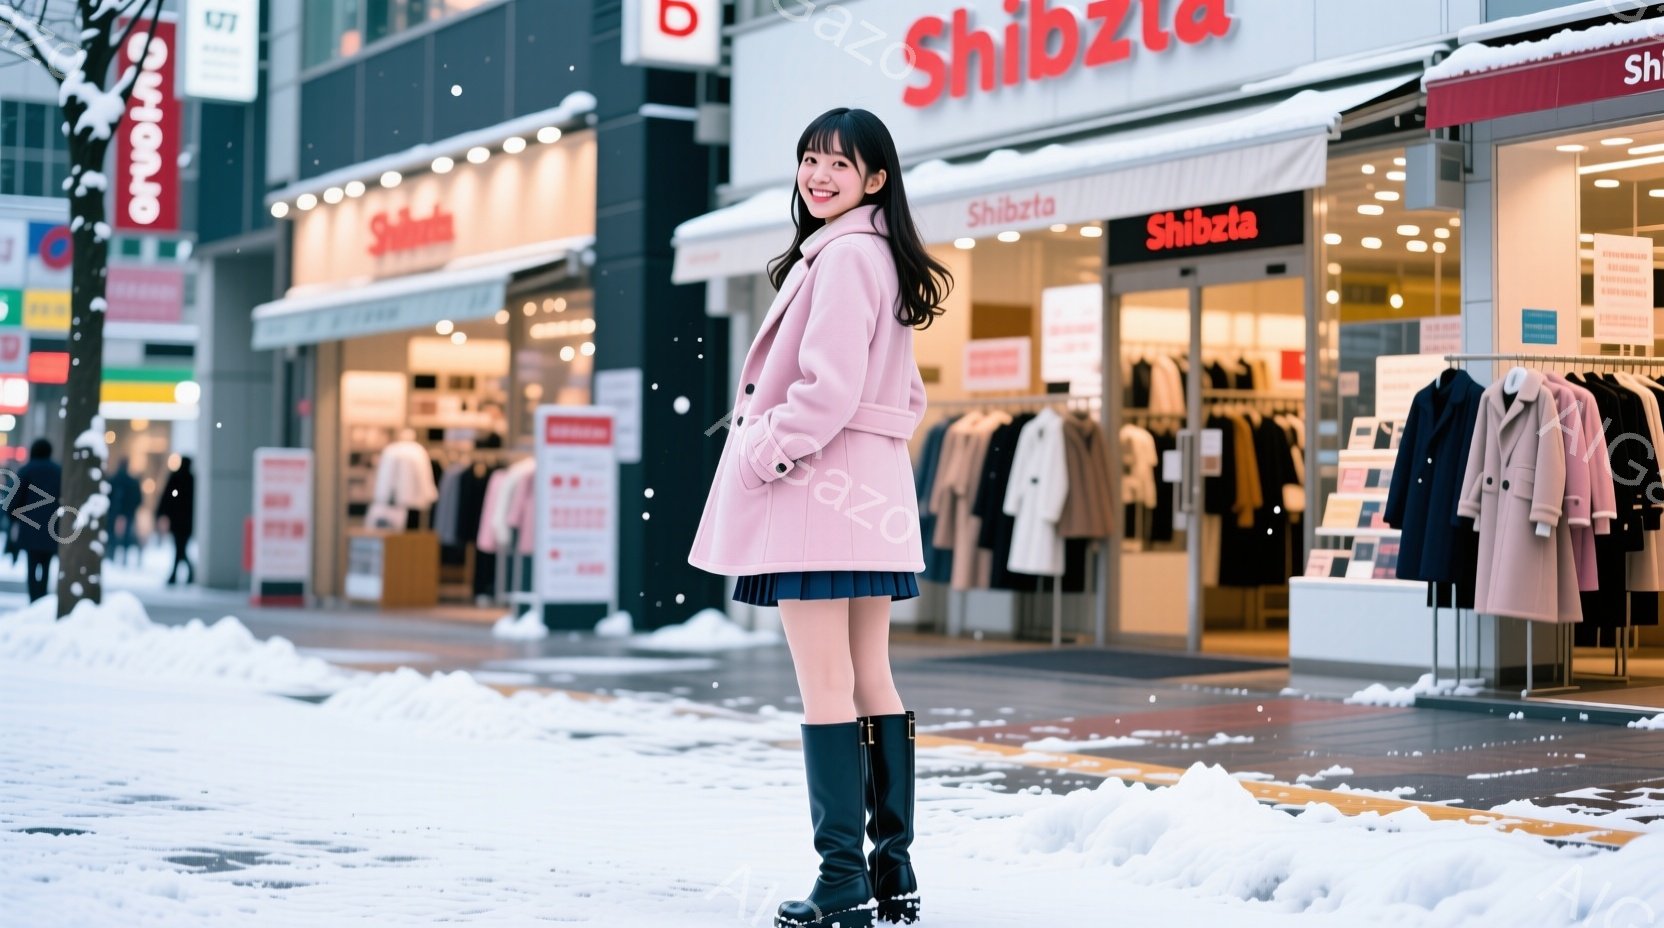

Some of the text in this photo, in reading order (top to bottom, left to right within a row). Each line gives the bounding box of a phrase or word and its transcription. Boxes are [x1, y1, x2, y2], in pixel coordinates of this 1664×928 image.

[902, 0, 1232, 108] Shibzta
[966, 192, 1057, 230] Shibzta
[1145, 204, 1259, 251] Shibzta
